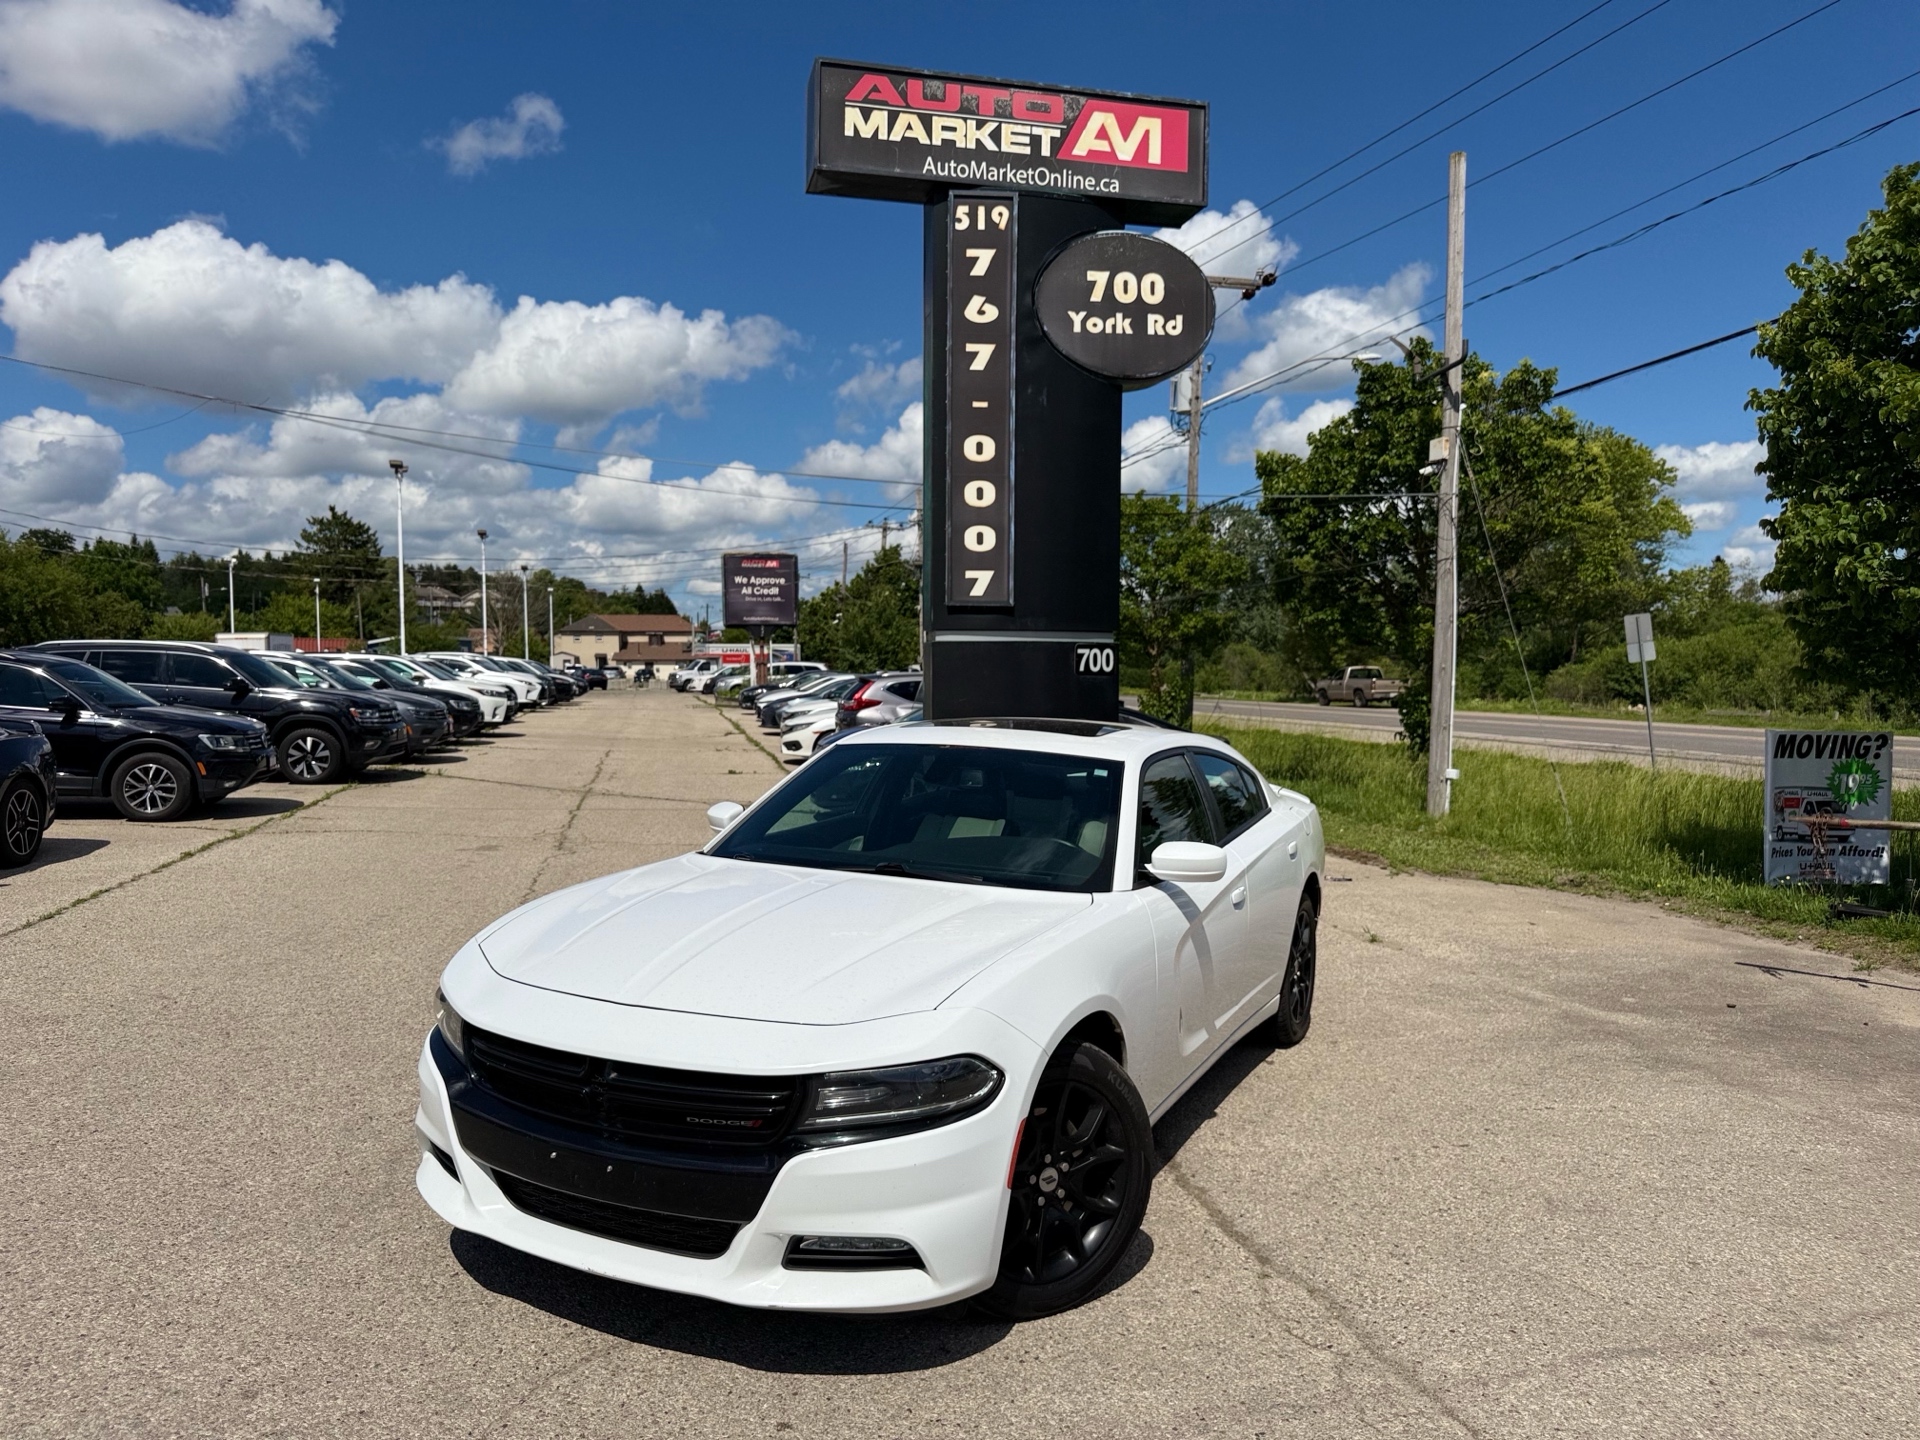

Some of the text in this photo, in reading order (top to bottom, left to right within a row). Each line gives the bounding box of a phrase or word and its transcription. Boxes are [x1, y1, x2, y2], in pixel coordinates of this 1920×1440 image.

[845, 73, 1064, 123] AUTO
[844, 106, 1061, 158] MARKET
[922, 155, 1120, 194] AutoMarketOnline.ca
[954, 204, 1010, 231] 519
[1086, 270, 1165, 305] 700
[1067, 310, 1184, 336] York Rd
[734, 575, 786, 586] We Approve
[741, 586, 779, 595] All Credit
[1077, 648, 1114, 673] 700
[1773, 733, 1889, 760] MOVING?
[1771, 846, 1793, 859] Prices
[1796, 845, 1813, 857] You
[1838, 845, 1886, 858] Afford!
[1107, 1070, 1144, 1122] KUMHO
[686, 1116, 753, 1127] DODGE
